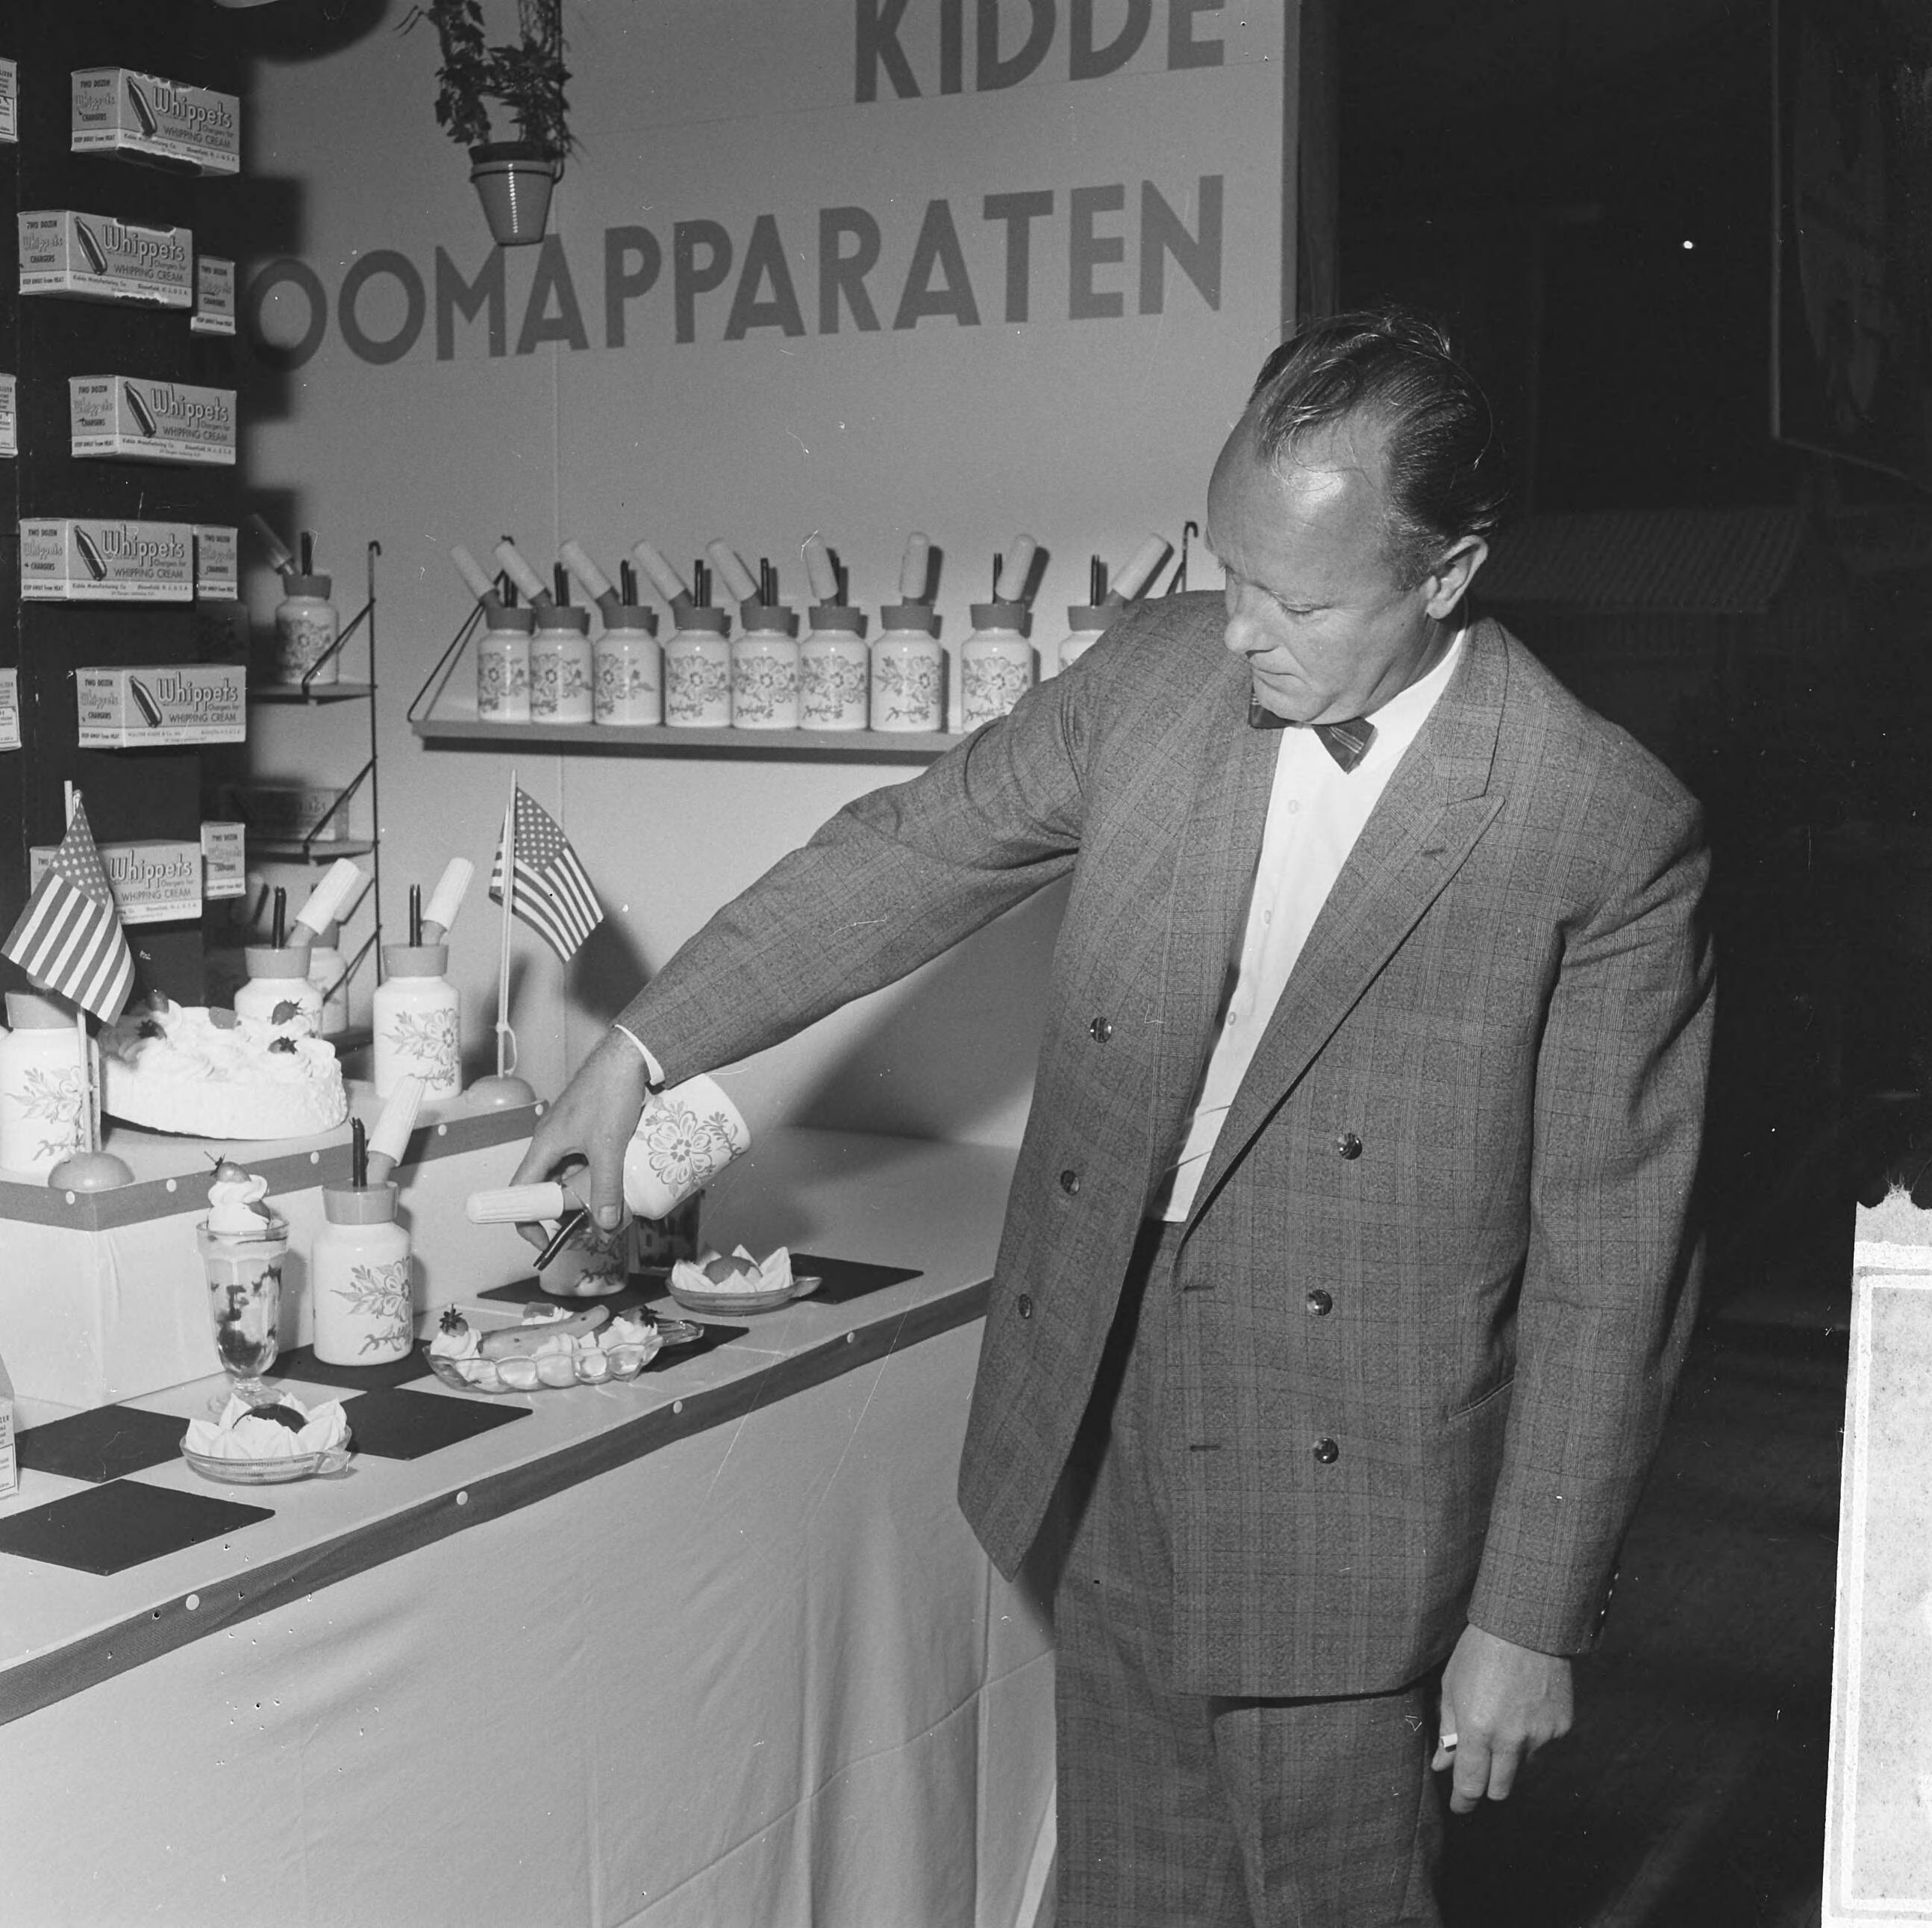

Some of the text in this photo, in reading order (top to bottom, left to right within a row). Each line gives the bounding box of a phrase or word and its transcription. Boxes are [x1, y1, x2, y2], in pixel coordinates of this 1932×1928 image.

[855, 0, 1225, 102] KIDDE
[152, 86, 232, 131] Whippets
[163, 125, 202, 143] WHIPPING
[205, 134, 231, 147] CREAM
[102, 224, 185, 267] Whippets
[114, 263, 183, 281] WHIPPING CREAM
[249, 174, 1225, 371] OOMAPPARATEN
[151, 383, 228, 428] Whippets
[162, 425, 228, 441] WHIPPING CREAM
[28, 528, 39, 537] TWO
[102, 523, 184, 567] Whippets
[114, 567, 184, 578] WHIPPING CREAM
[157, 671, 238, 711] Whippets
[169, 713, 236, 723] WHIPPING CREAM
[110, 849, 193, 889] Whippets
[120, 888, 192, 902] WHIPPING CREAM
